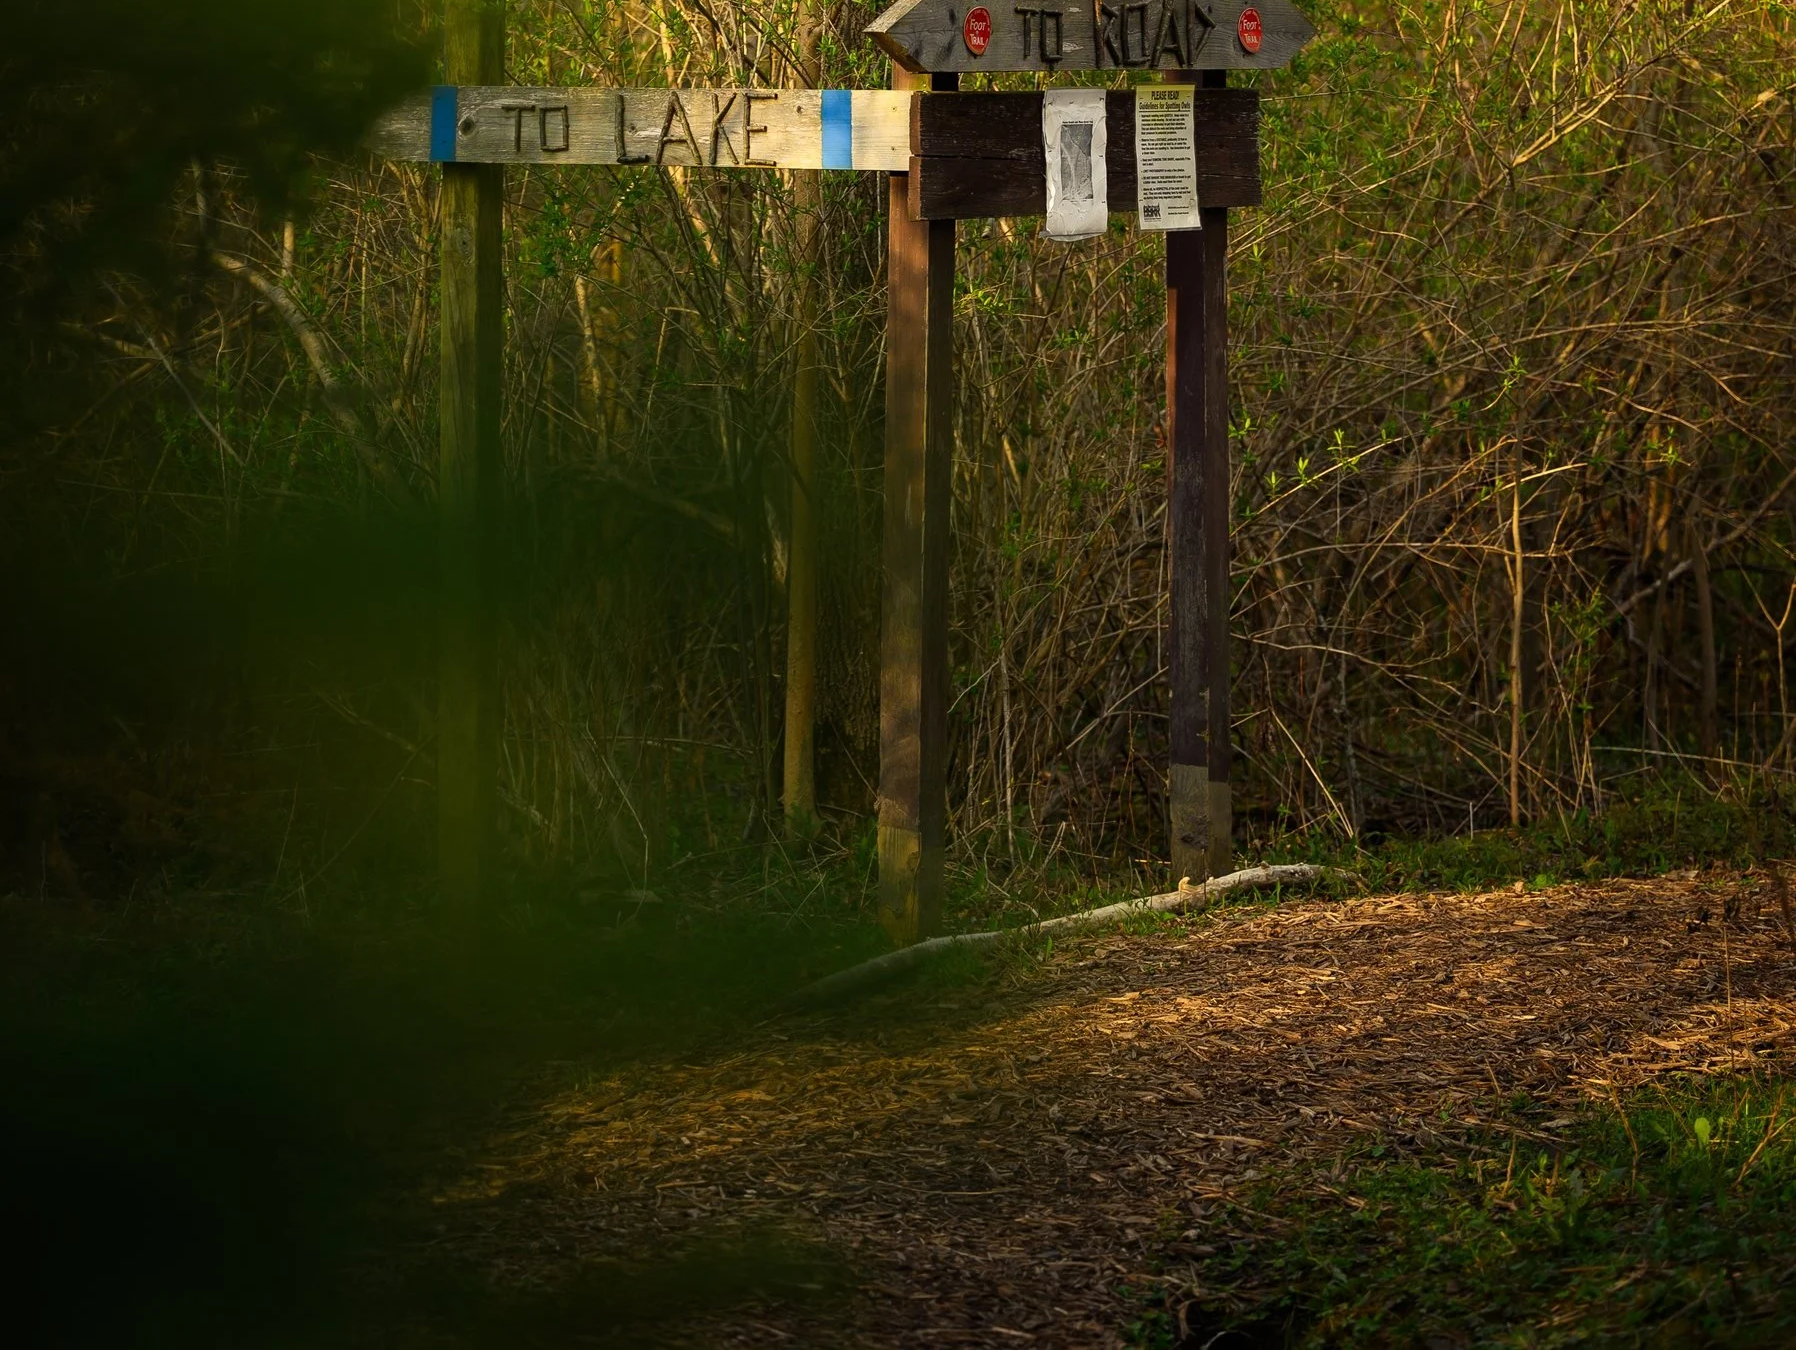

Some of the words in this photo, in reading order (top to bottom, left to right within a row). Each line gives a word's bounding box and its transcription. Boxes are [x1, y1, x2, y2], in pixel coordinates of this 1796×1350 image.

[1014, 5, 1063, 64] TO
[1139, 102, 1159, 110] Guidelines
[1165, 101, 1181, 111] Spotting
[1181, 101, 1191, 110] Owls
[1151, 90, 1167, 101] PLEASE
[501, 104, 570, 152] TO
[614, 90, 779, 167] LAKE
